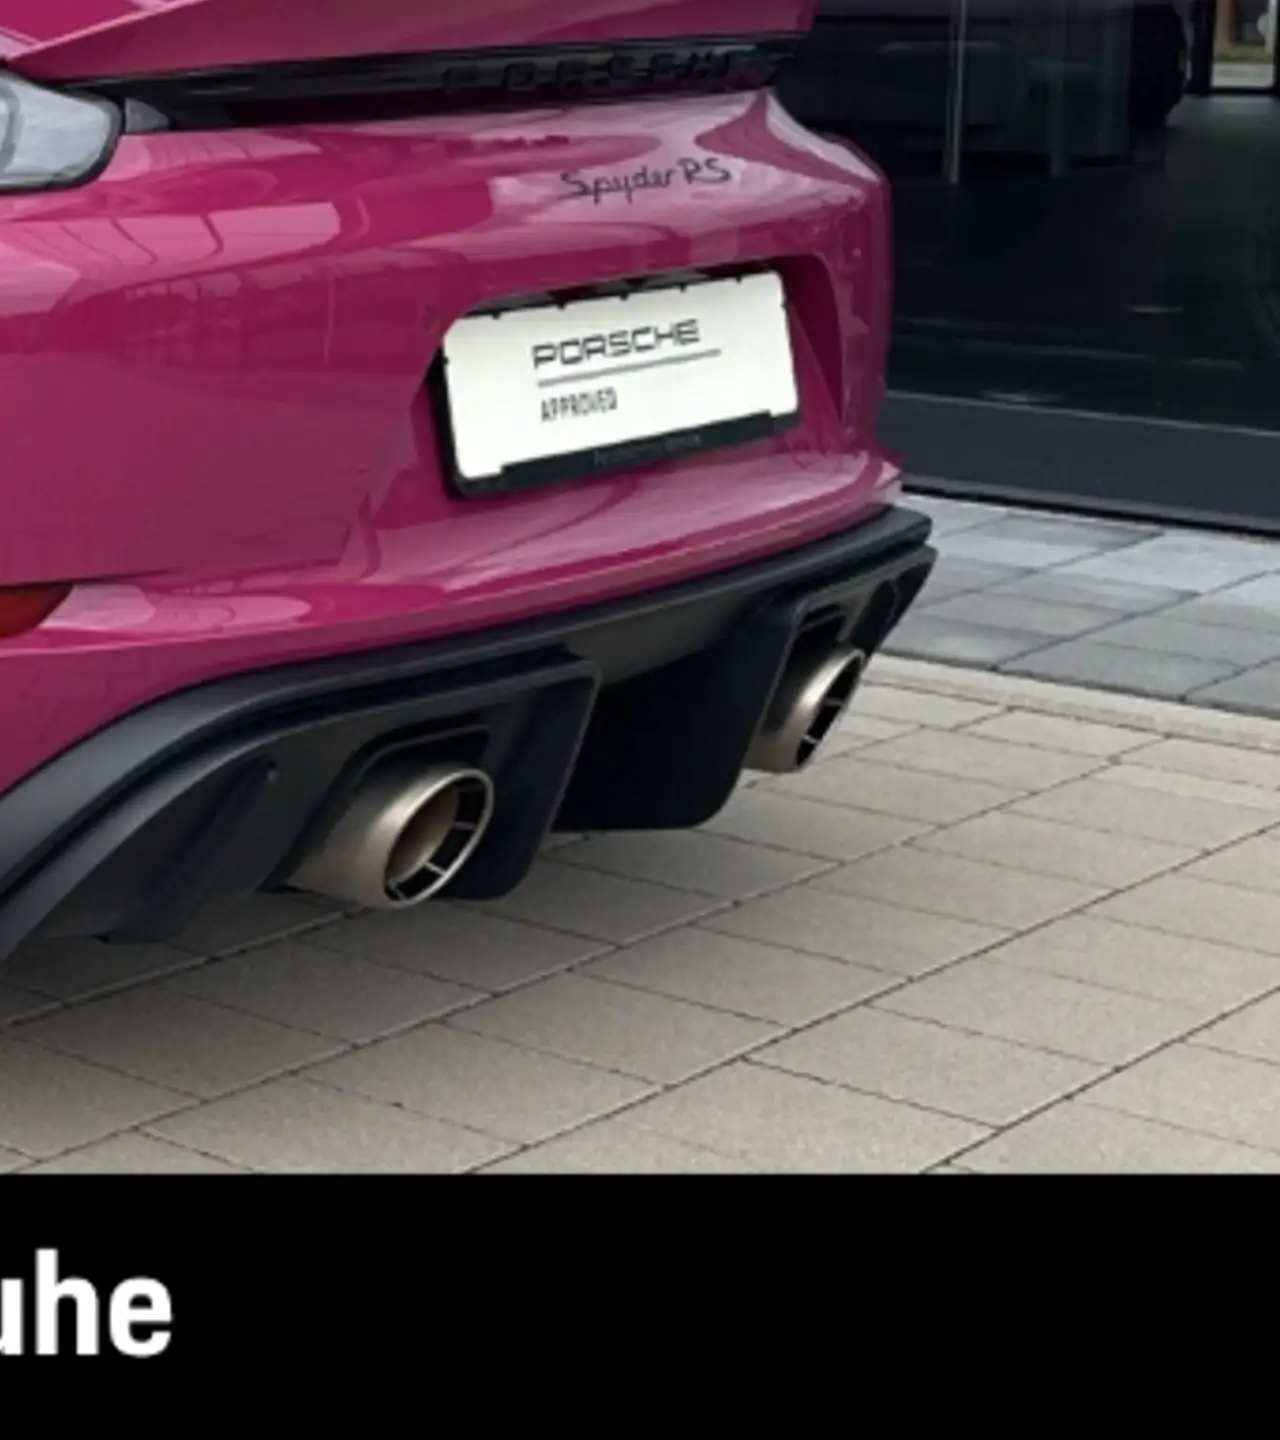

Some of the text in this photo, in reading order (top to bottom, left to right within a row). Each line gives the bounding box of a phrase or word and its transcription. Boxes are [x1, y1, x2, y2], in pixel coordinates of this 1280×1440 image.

[558, 157, 732, 205] Spyder RS
[532, 318, 700, 369] PORSCHE
[540, 386, 618, 422] APPROVED
